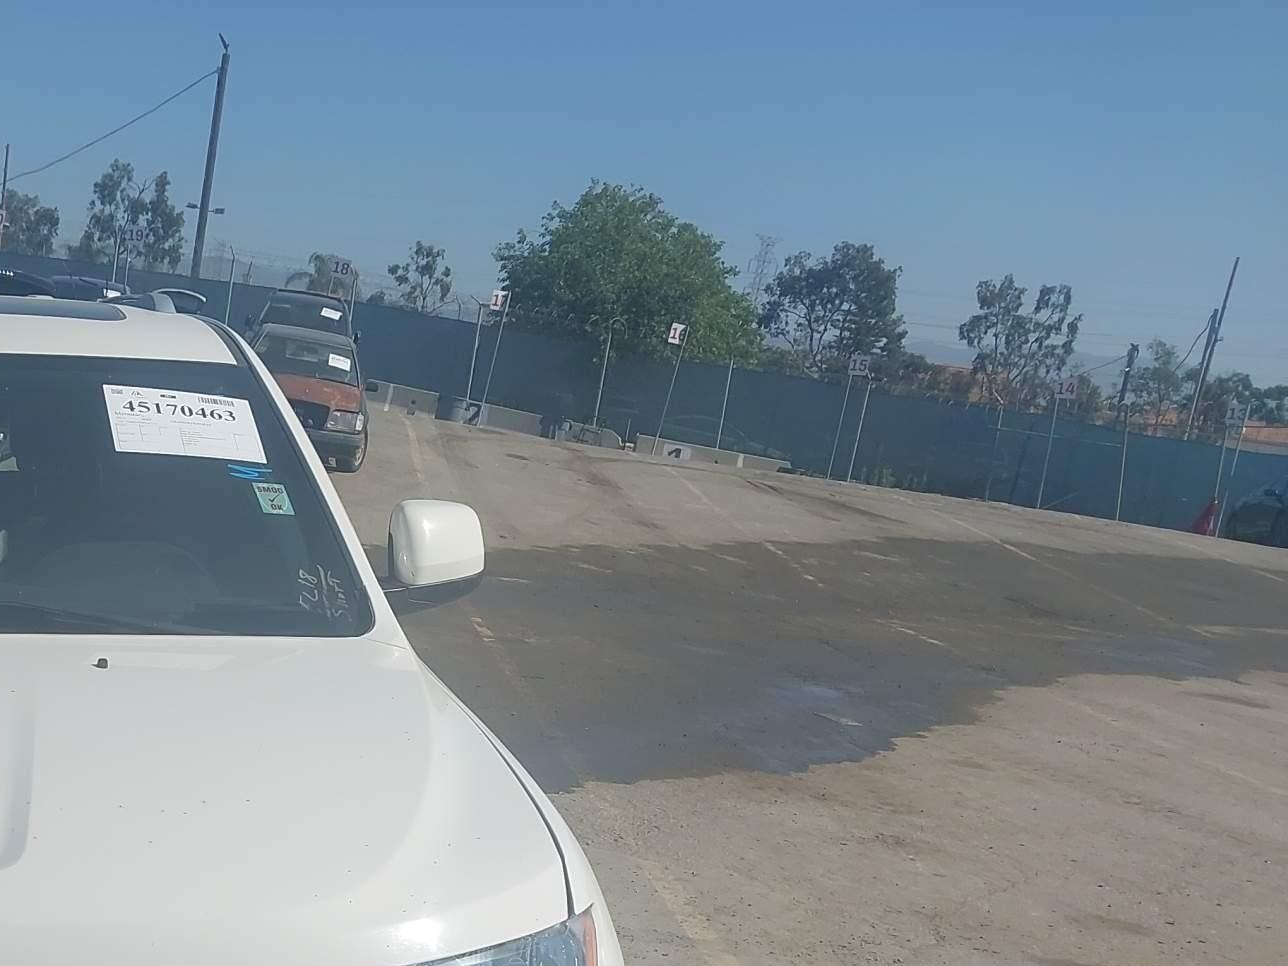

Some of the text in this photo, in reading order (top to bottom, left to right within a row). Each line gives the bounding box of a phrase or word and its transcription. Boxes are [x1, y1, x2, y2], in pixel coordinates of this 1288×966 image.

[127, 229, 144, 241] 19
[331, 261, 350, 275] 18
[669, 327, 686, 341] 16
[849, 359, 868, 372] 15
[1056, 382, 1075, 395] 14
[122, 399, 237, 422] 45170463
[270, 503, 284, 511] OK
